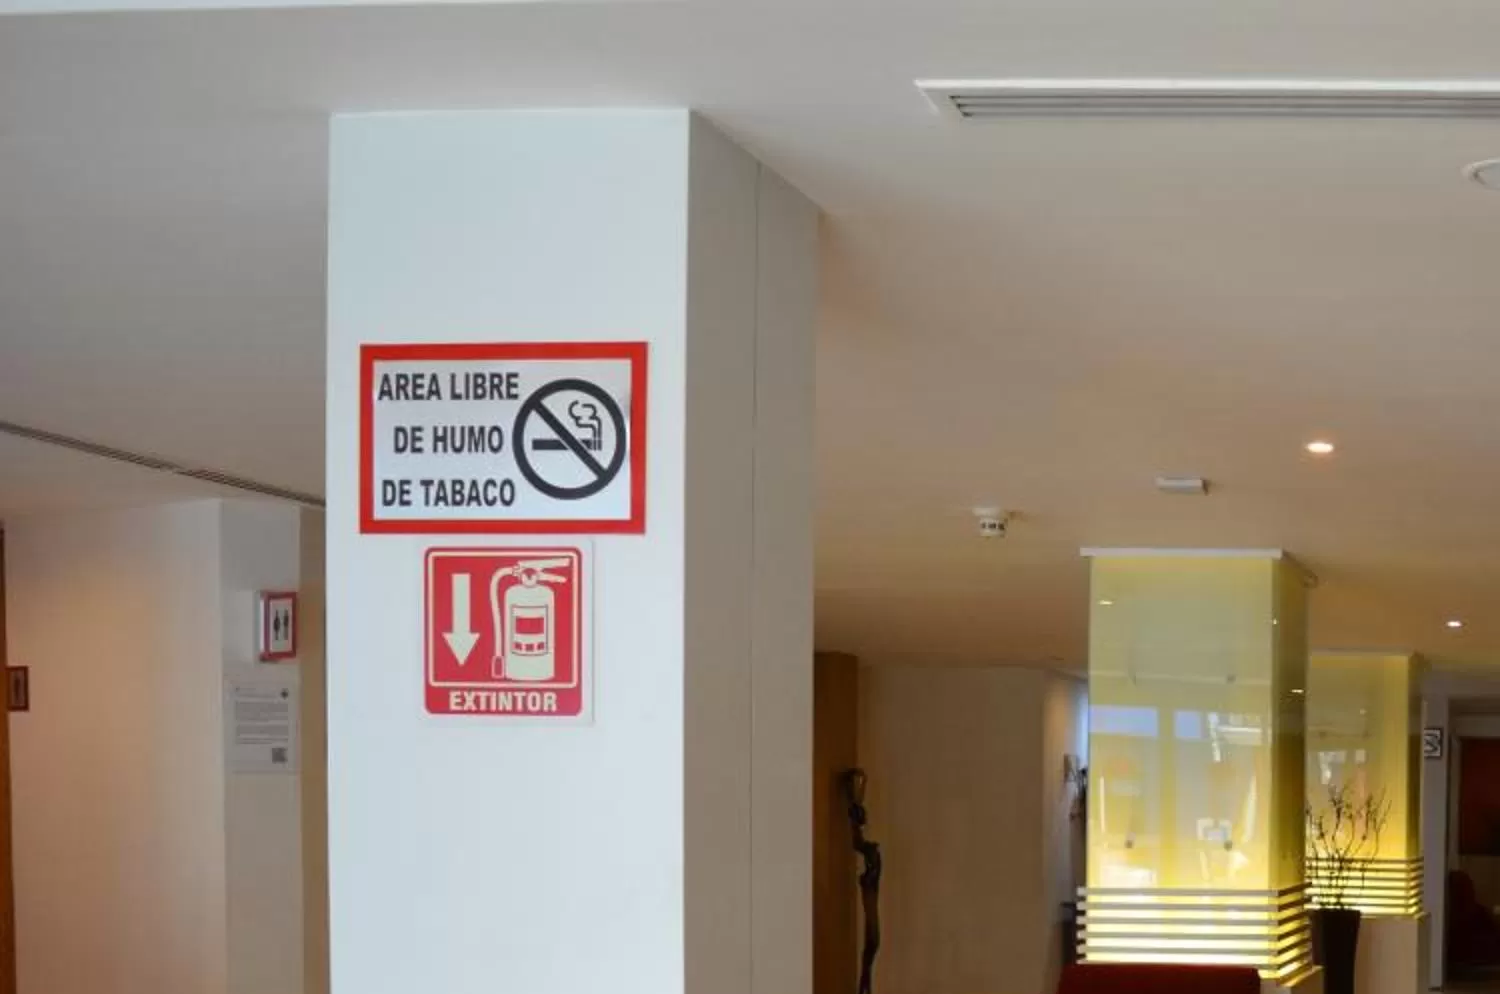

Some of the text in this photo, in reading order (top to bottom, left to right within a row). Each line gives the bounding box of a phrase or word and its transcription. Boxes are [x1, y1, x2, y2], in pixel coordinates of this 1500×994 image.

[378, 372, 519, 401] AREA LIBRE
[393, 425, 504, 454] DE HUMO
[382, 478, 516, 507] DE TABACO
[449, 690, 558, 712] EXTINTOR
